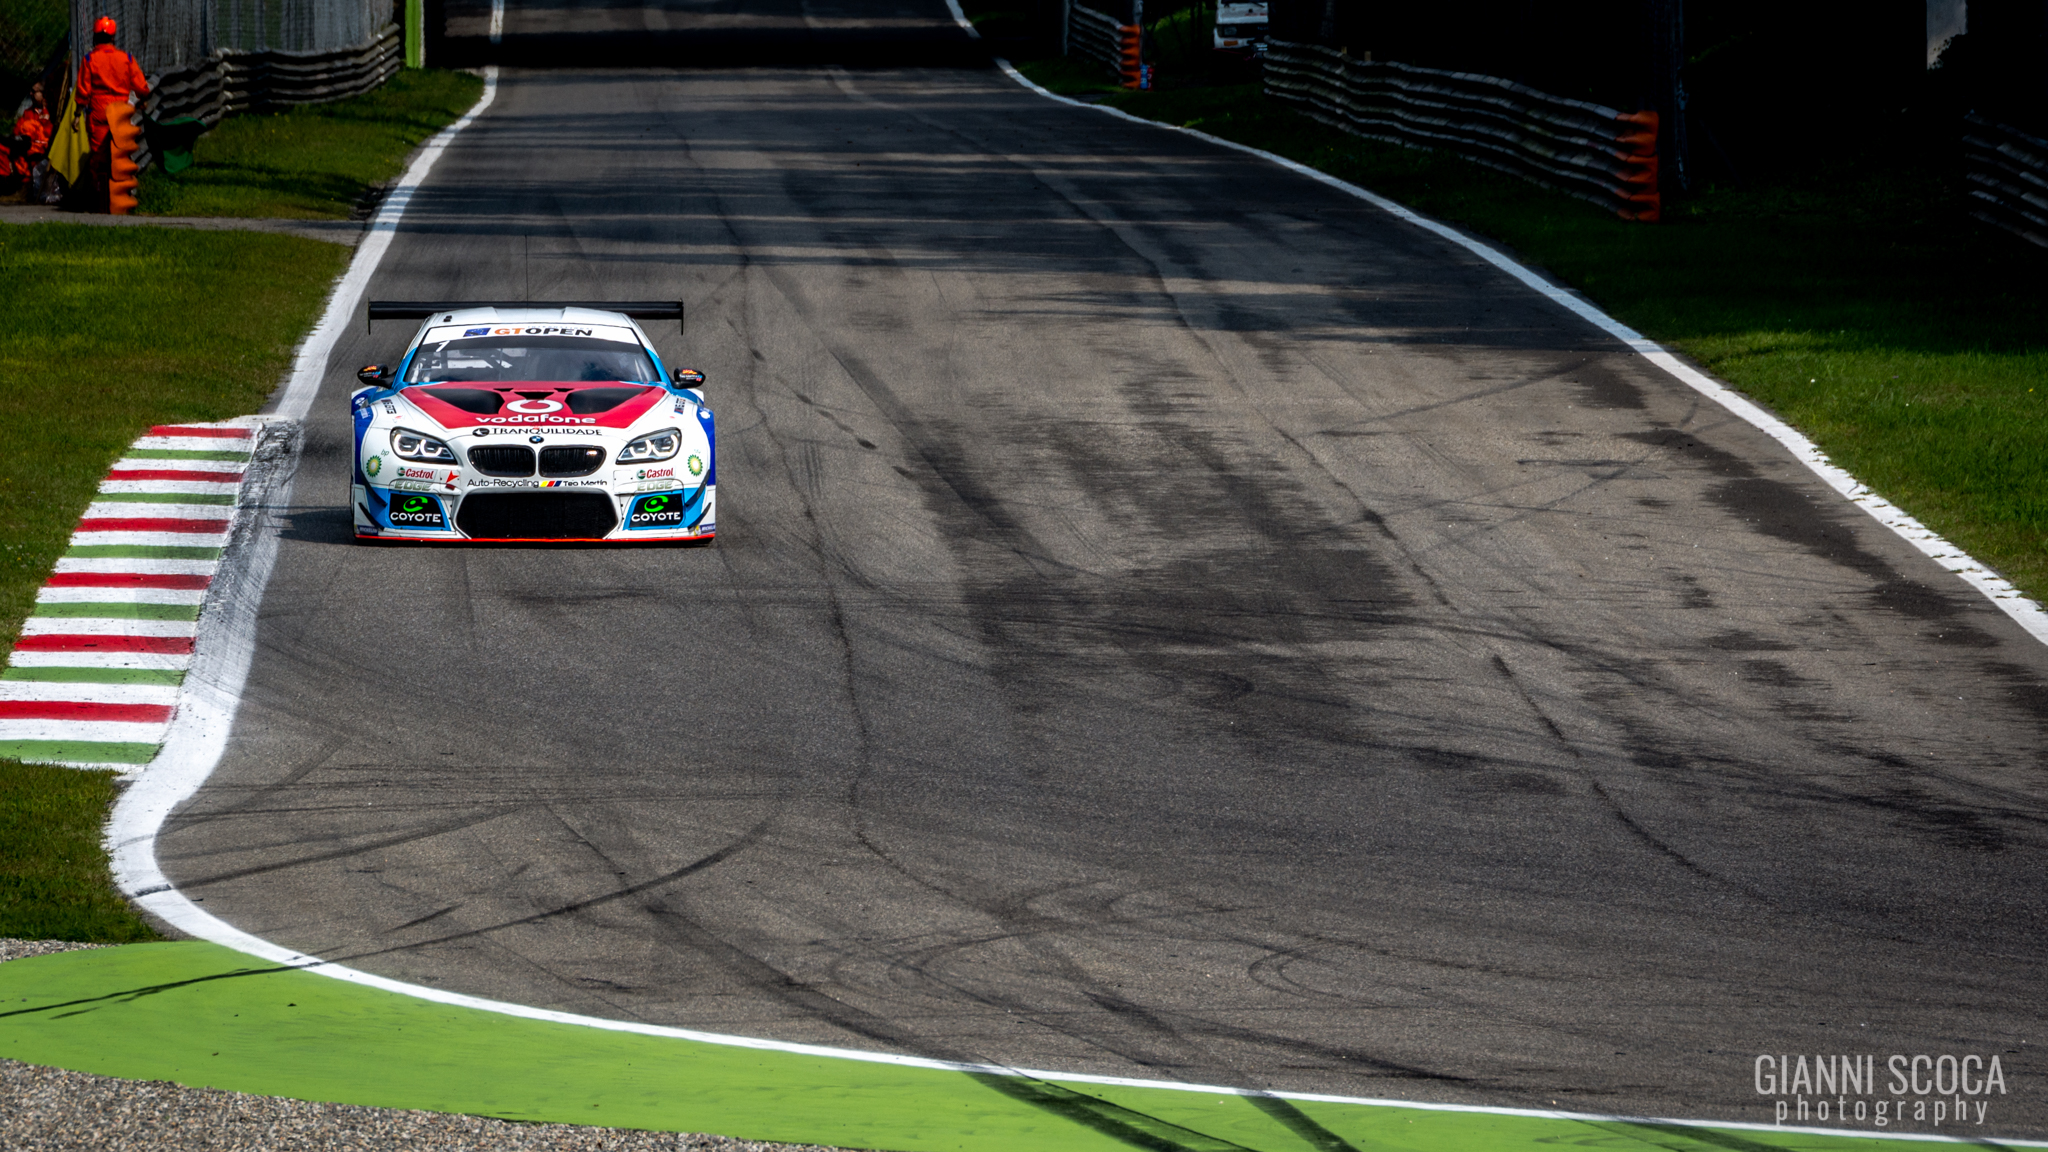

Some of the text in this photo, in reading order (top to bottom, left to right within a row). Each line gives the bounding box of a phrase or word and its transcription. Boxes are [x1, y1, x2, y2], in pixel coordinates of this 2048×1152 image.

[435, 340, 450, 352] 1
[475, 414, 596, 424] vodafone
[491, 428, 602, 436] TRANQUILIDADE
[405, 468, 434, 479] Castrol
[646, 467, 674, 478] Castrol
[394, 480, 431, 491] EDGE
[467, 479, 539, 488] Auto-Recycling
[637, 480, 673, 491] EDGE
[390, 512, 441, 523] COYOTE
[631, 512, 681, 522] COYOTE
